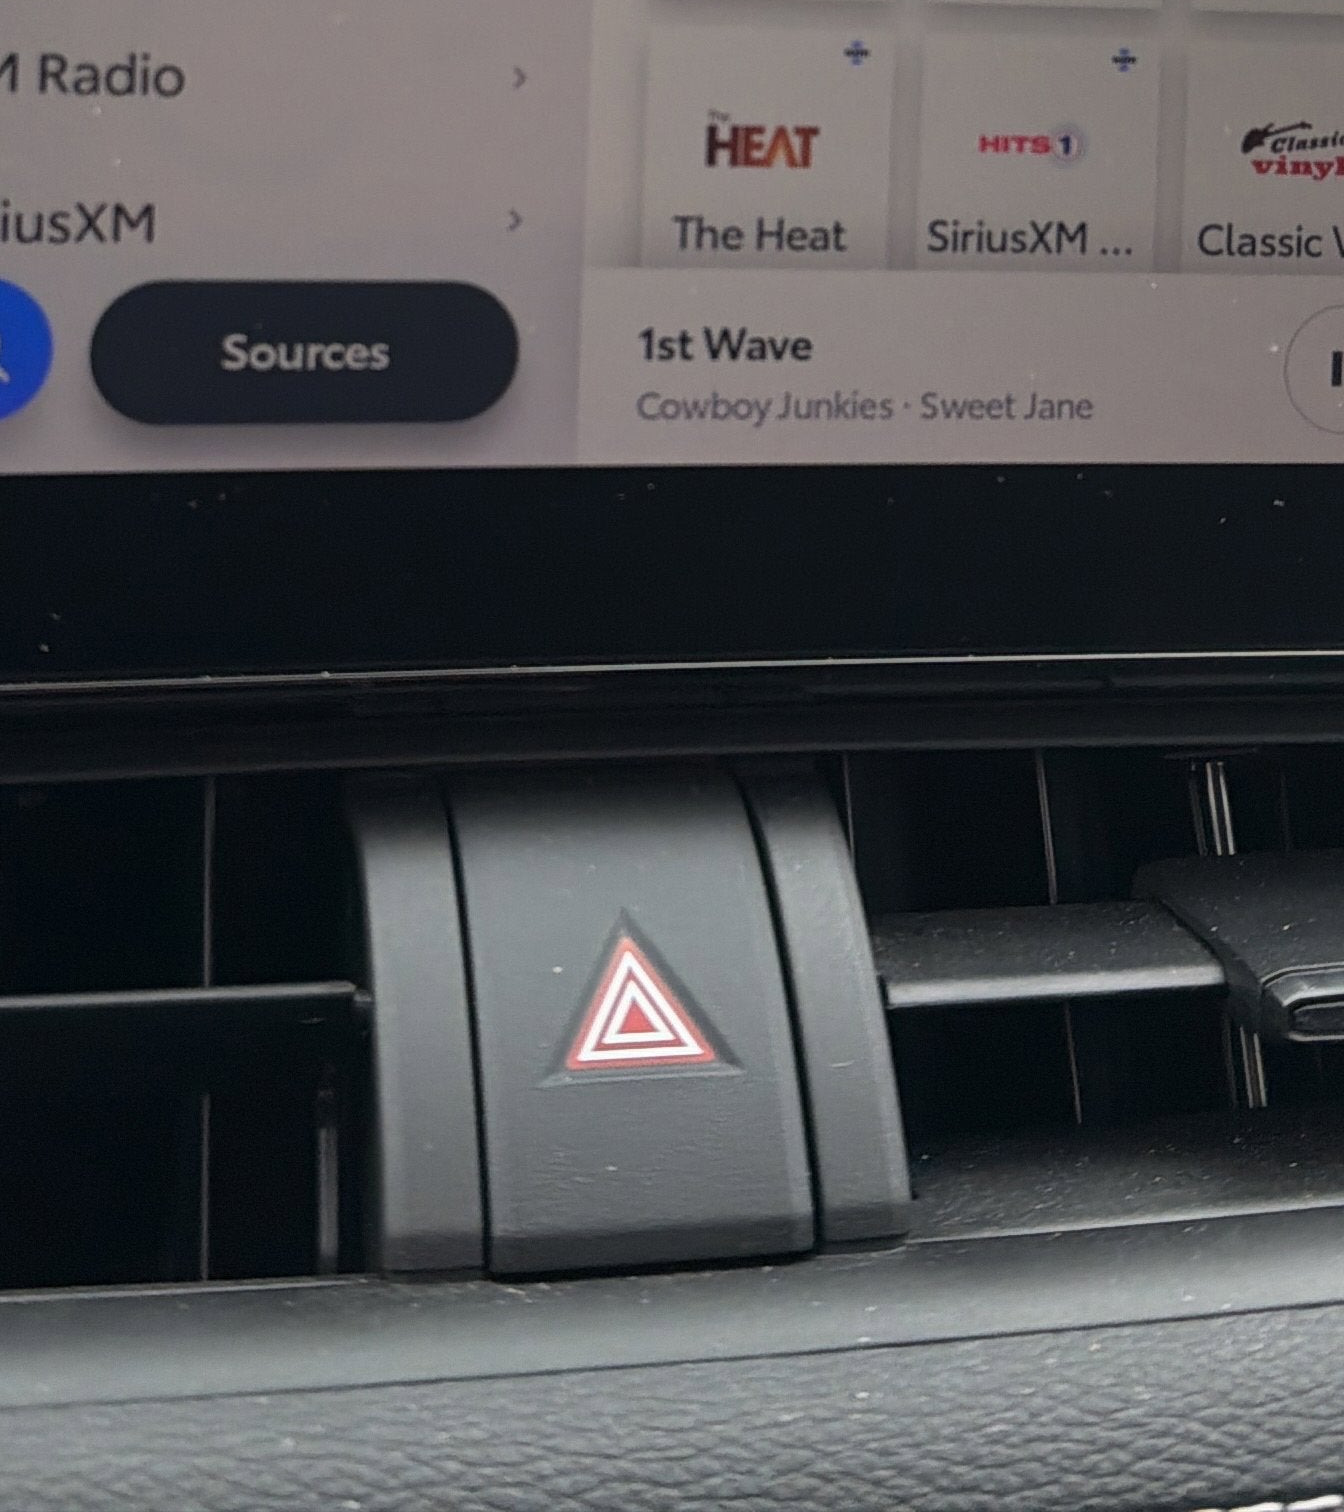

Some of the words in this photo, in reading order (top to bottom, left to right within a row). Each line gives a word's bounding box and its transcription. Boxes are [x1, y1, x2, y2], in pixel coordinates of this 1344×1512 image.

[38, 52, 185, 98] Radio
[705, 123, 821, 169] HEAT
[980, 136, 1052, 154] HITS
[1059, 135, 1071, 156] 1
[674, 215, 745, 252] The
[756, 217, 847, 253] Heat
[928, 219, 1087, 255] SiriusXM
[1197, 222, 1323, 259] Classic
[221, 333, 390, 371] Sources
[640, 328, 694, 361] 1st
[703, 327, 813, 361] Wave
[636, 391, 773, 427] Cowboy
[776, 390, 894, 421] Junkies
[921, 391, 1016, 421] Sweet
[1023, 392, 1094, 421] Jane
